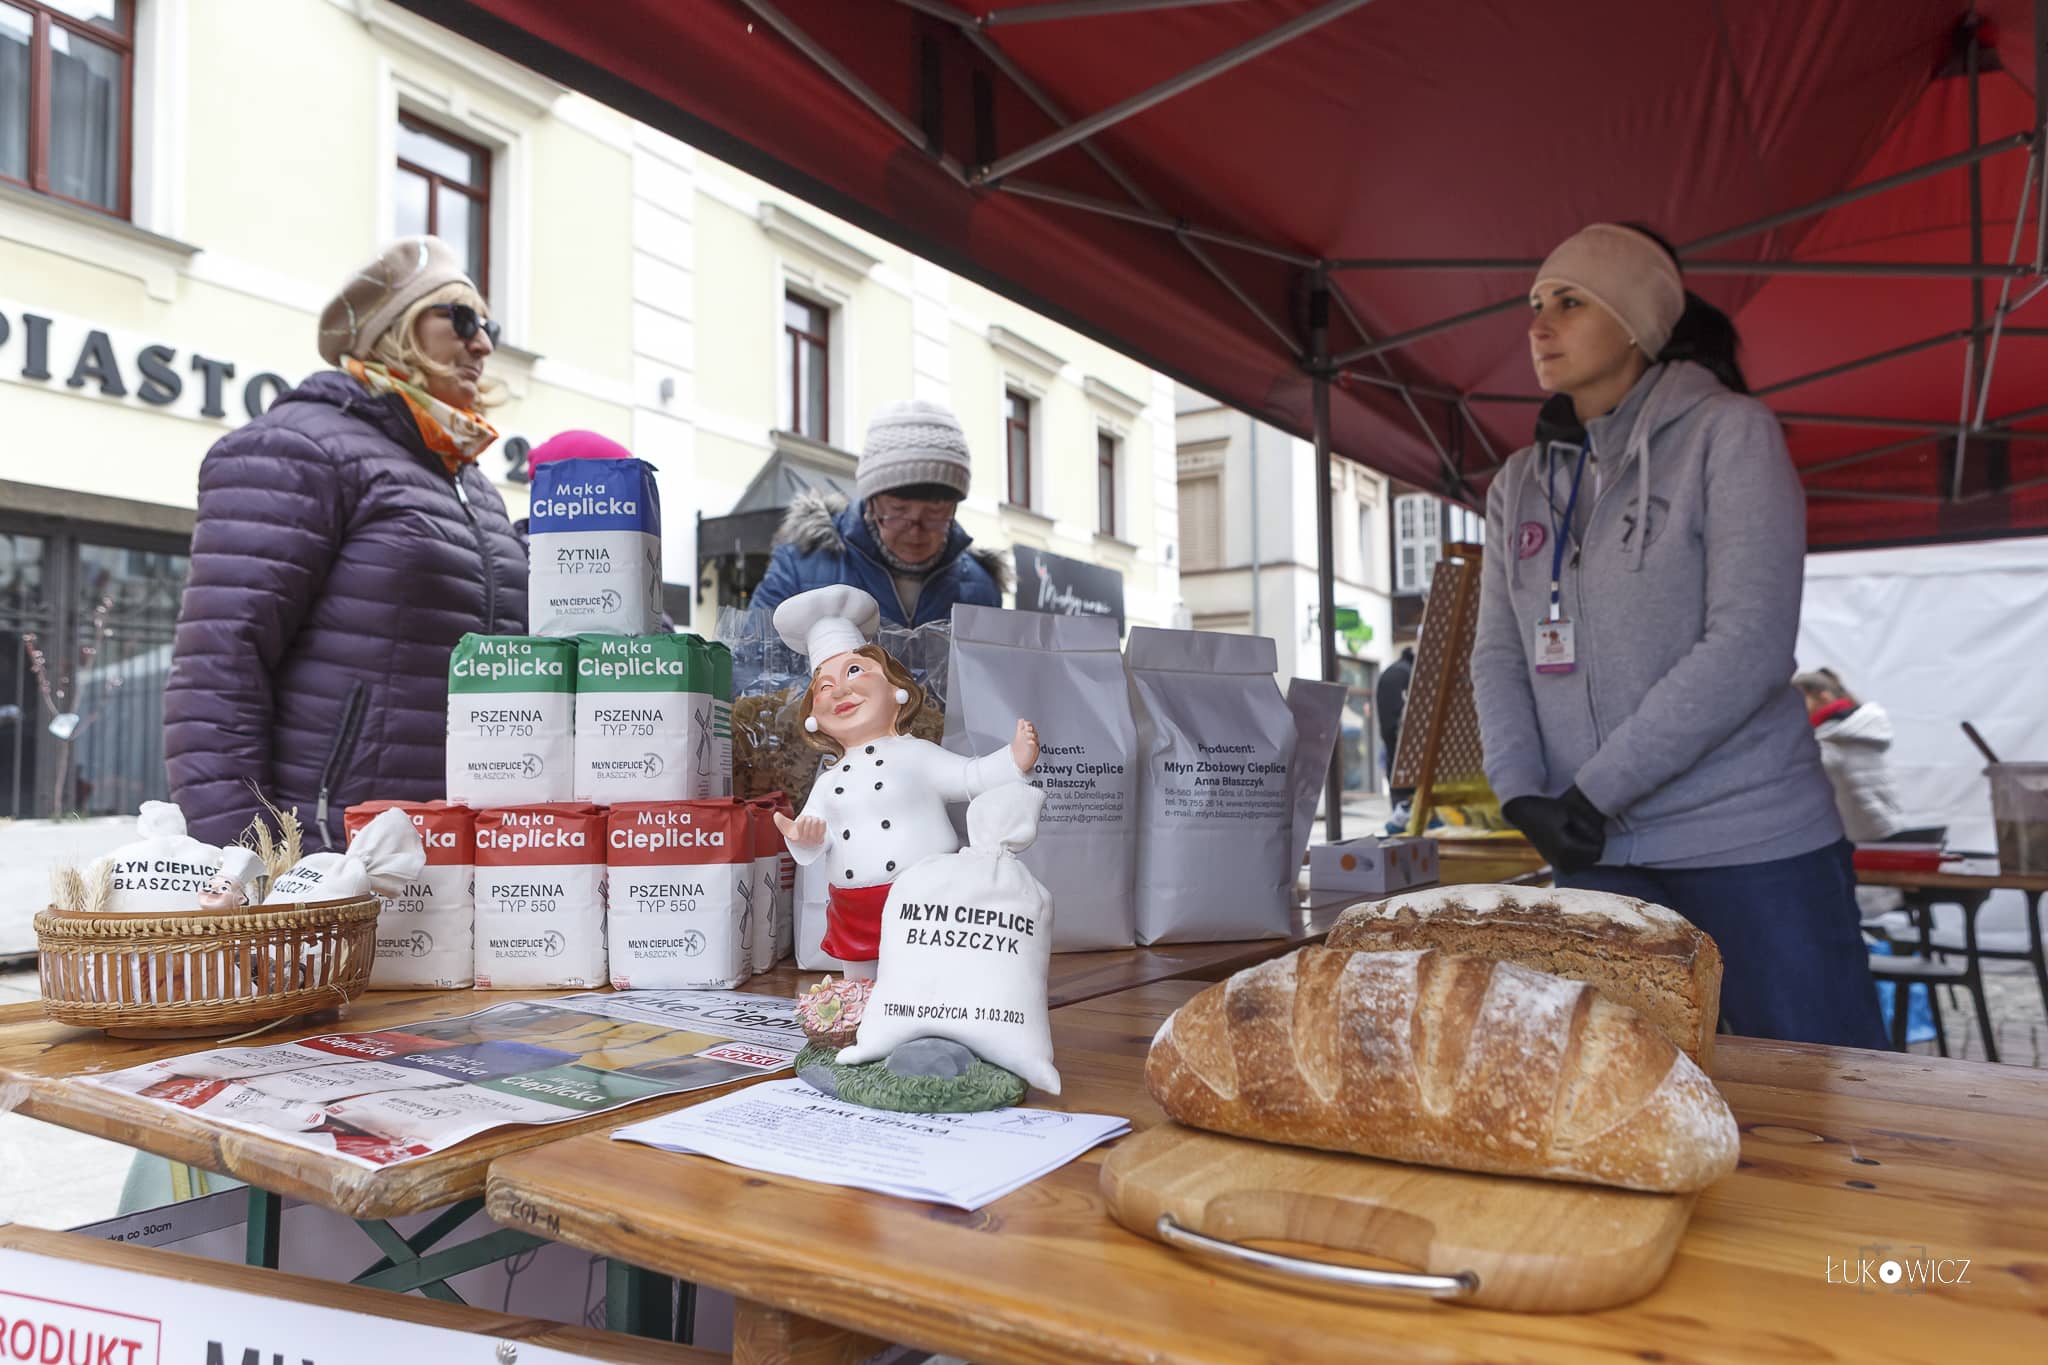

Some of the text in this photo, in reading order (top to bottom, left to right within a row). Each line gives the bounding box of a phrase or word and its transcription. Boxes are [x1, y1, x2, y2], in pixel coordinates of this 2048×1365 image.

[556, 483, 605, 498] Mąka
[533, 498, 637, 519] Cieplicka
[557, 547, 610, 561] ŻYTNIA
[557, 562, 611, 574] TYP 720
[550, 597, 601, 607] MŁYN CIEPLICE
[555, 607, 596, 616] BŁASZCZYK
[478, 641, 532, 657] Mąka
[601, 641, 652, 657] Mąka
[453, 657, 563, 680] Cieplicka
[578, 657, 684, 680] Cieplicka
[470, 710, 543, 723] PSZENNA
[594, 710, 663, 722] PSZENNA
[478, 725, 533, 736] TYP 750
[601, 724, 654, 736] TYP 750
[1040, 744, 1085, 755] ducent:
[1198, 743, 1256, 754] Producent:
[468, 761, 522, 770] MŁYN CIEPLICE
[592, 761, 644, 770] MŁYN CIEPLICE
[1034, 762, 1124, 776] ożowy Cieplice
[1164, 761, 1286, 775] Młyn Zbożowy Cieplice
[473, 772, 516, 780] BŁASZCZYK
[597, 772, 637, 780] BŁASZCZYK
[1194, 777, 1264, 788] Anna Błaszczyk
[1047, 778, 1096, 790] Błaszczyk
[502, 812, 555, 828] Mąka
[637, 810, 691, 828] Mąka
[475, 828, 586, 852] Cieplicka
[610, 828, 724, 852] Cieplicka
[491, 884, 564, 898] PSZENNA
[629, 884, 704, 898] PSZENNA
[398, 900, 424, 913] 550
[498, 900, 556, 913] TYP 550
[637, 900, 696, 912] TYP 550
[900, 903, 1035, 936] MŁYN CIEPLICE
[489, 939, 543, 949] MŁYN CIEPLICE
[628, 938, 684, 949] MŁYN CIEPLICE
[906, 928, 1019, 955] BŁASZCZYK
[495, 950, 537, 959] BŁASZCZYK
[634, 950, 678, 959] BŁASZCZYK
[884, 1003, 1025, 1024] TERMIN SPOŻYCIA 31.03.2023
[715, 1049, 781, 1067] POLSKI
[501, 1076, 607, 1103] Cieplicka
[143, 1222, 172, 1236] 30cm
